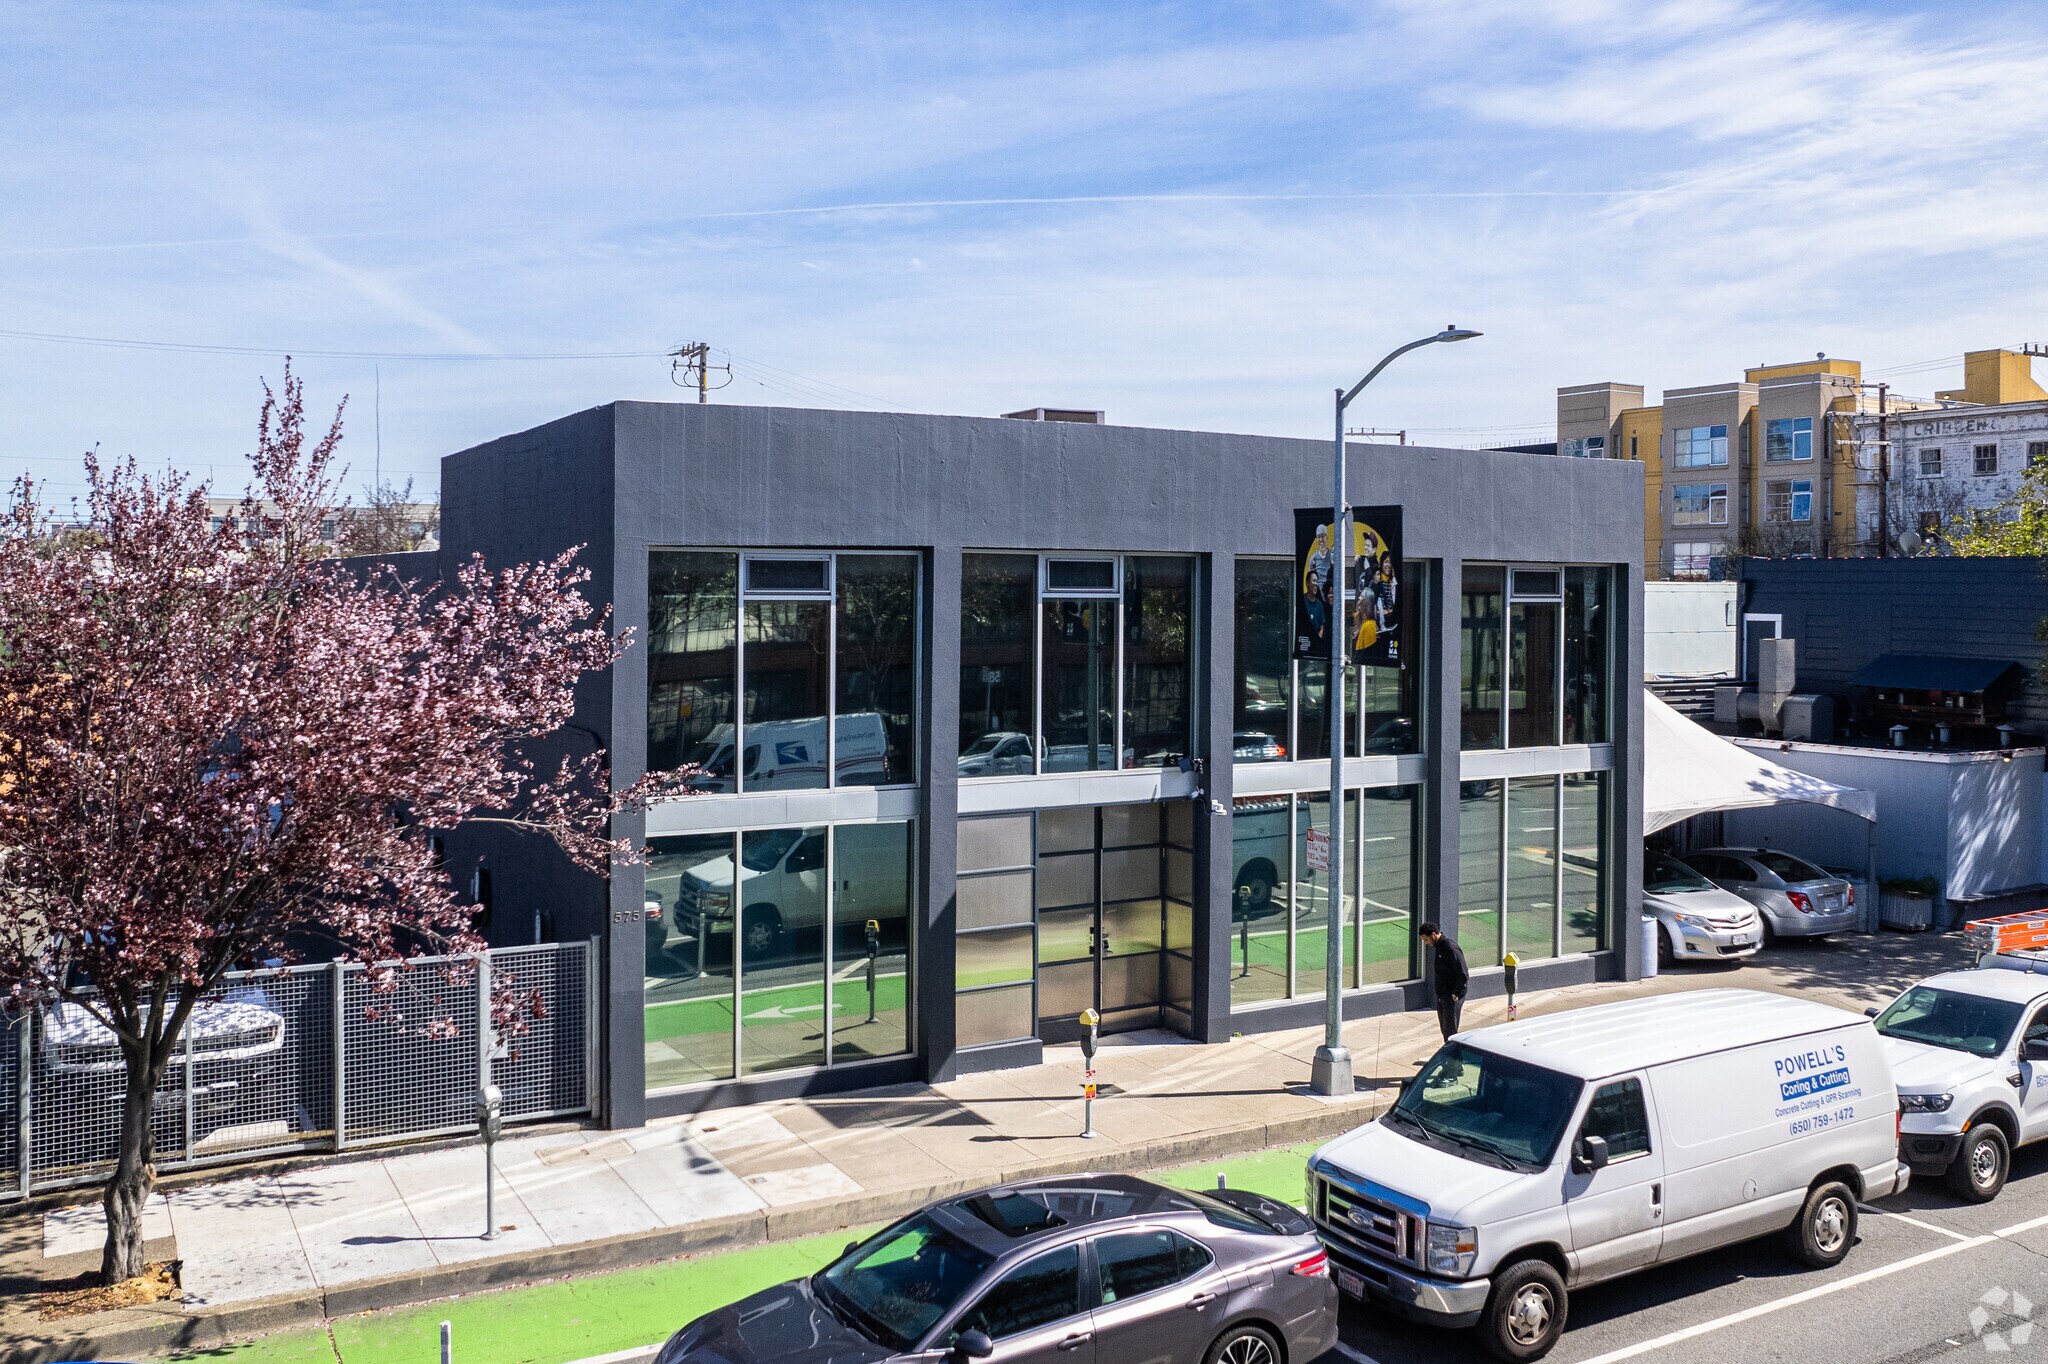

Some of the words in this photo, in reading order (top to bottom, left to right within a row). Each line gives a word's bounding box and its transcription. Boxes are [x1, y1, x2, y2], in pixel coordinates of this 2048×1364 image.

[613, 909, 640, 923] 575
[1774, 1045, 1845, 1077] POWELL'S
[1782, 1081, 1811, 1096] Coring
[1811, 1077, 1818, 1089] &
[1819, 1071, 1849, 1087] Cutting
[1775, 1104, 1800, 1117] Concrete
[1800, 1099, 1820, 1110] Cutting
[1825, 1092, 1838, 1103] GPR
[1837, 1088, 1862, 1099] Scanning
[1789, 1118, 1811, 1136] (650)
[1813, 1106, 1854, 1128] 759-1472
